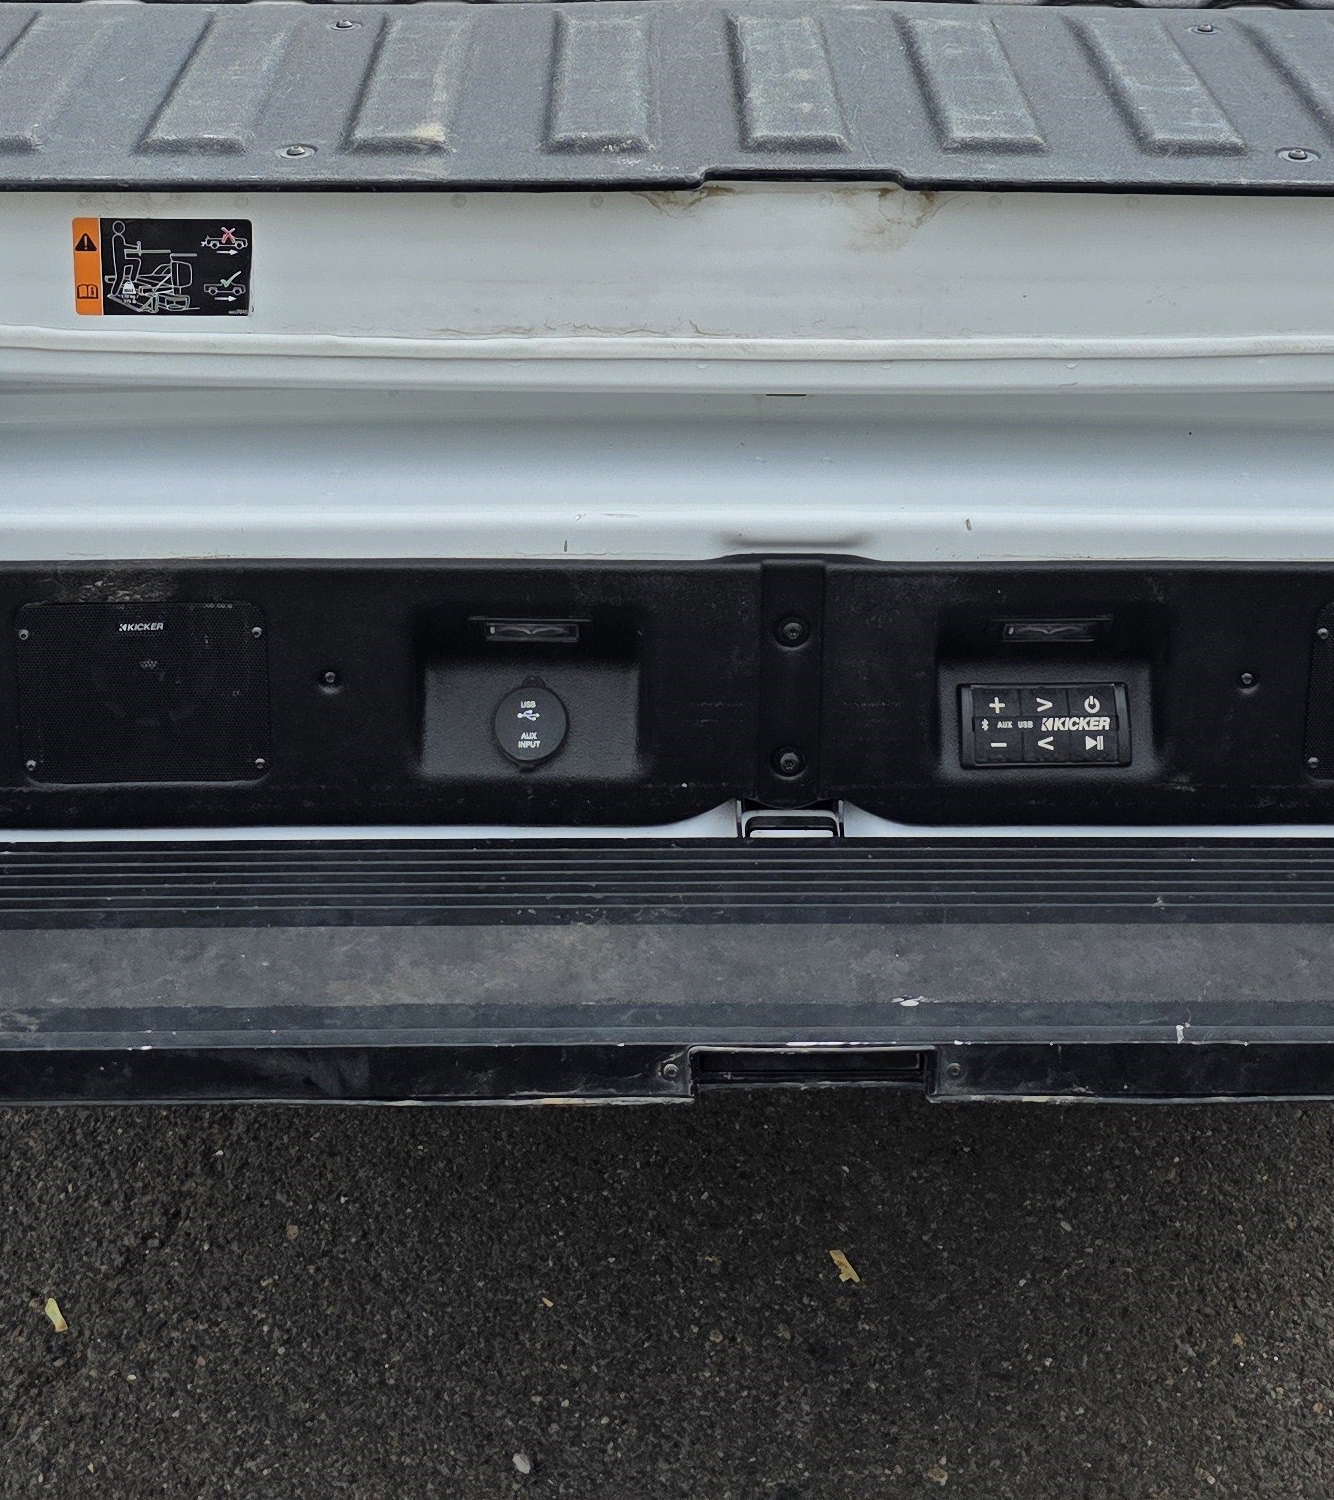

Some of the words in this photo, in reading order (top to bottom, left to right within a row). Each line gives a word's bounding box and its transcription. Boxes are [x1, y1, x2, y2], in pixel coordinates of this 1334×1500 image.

[126, 622, 164, 631] KICKER
[997, 720, 1013, 728] AUX
[1018, 720, 1033, 729] USB
[1053, 716, 1111, 731] KICKER
[521, 732, 538, 740] AUX
[517, 740, 541, 748] INPUT
